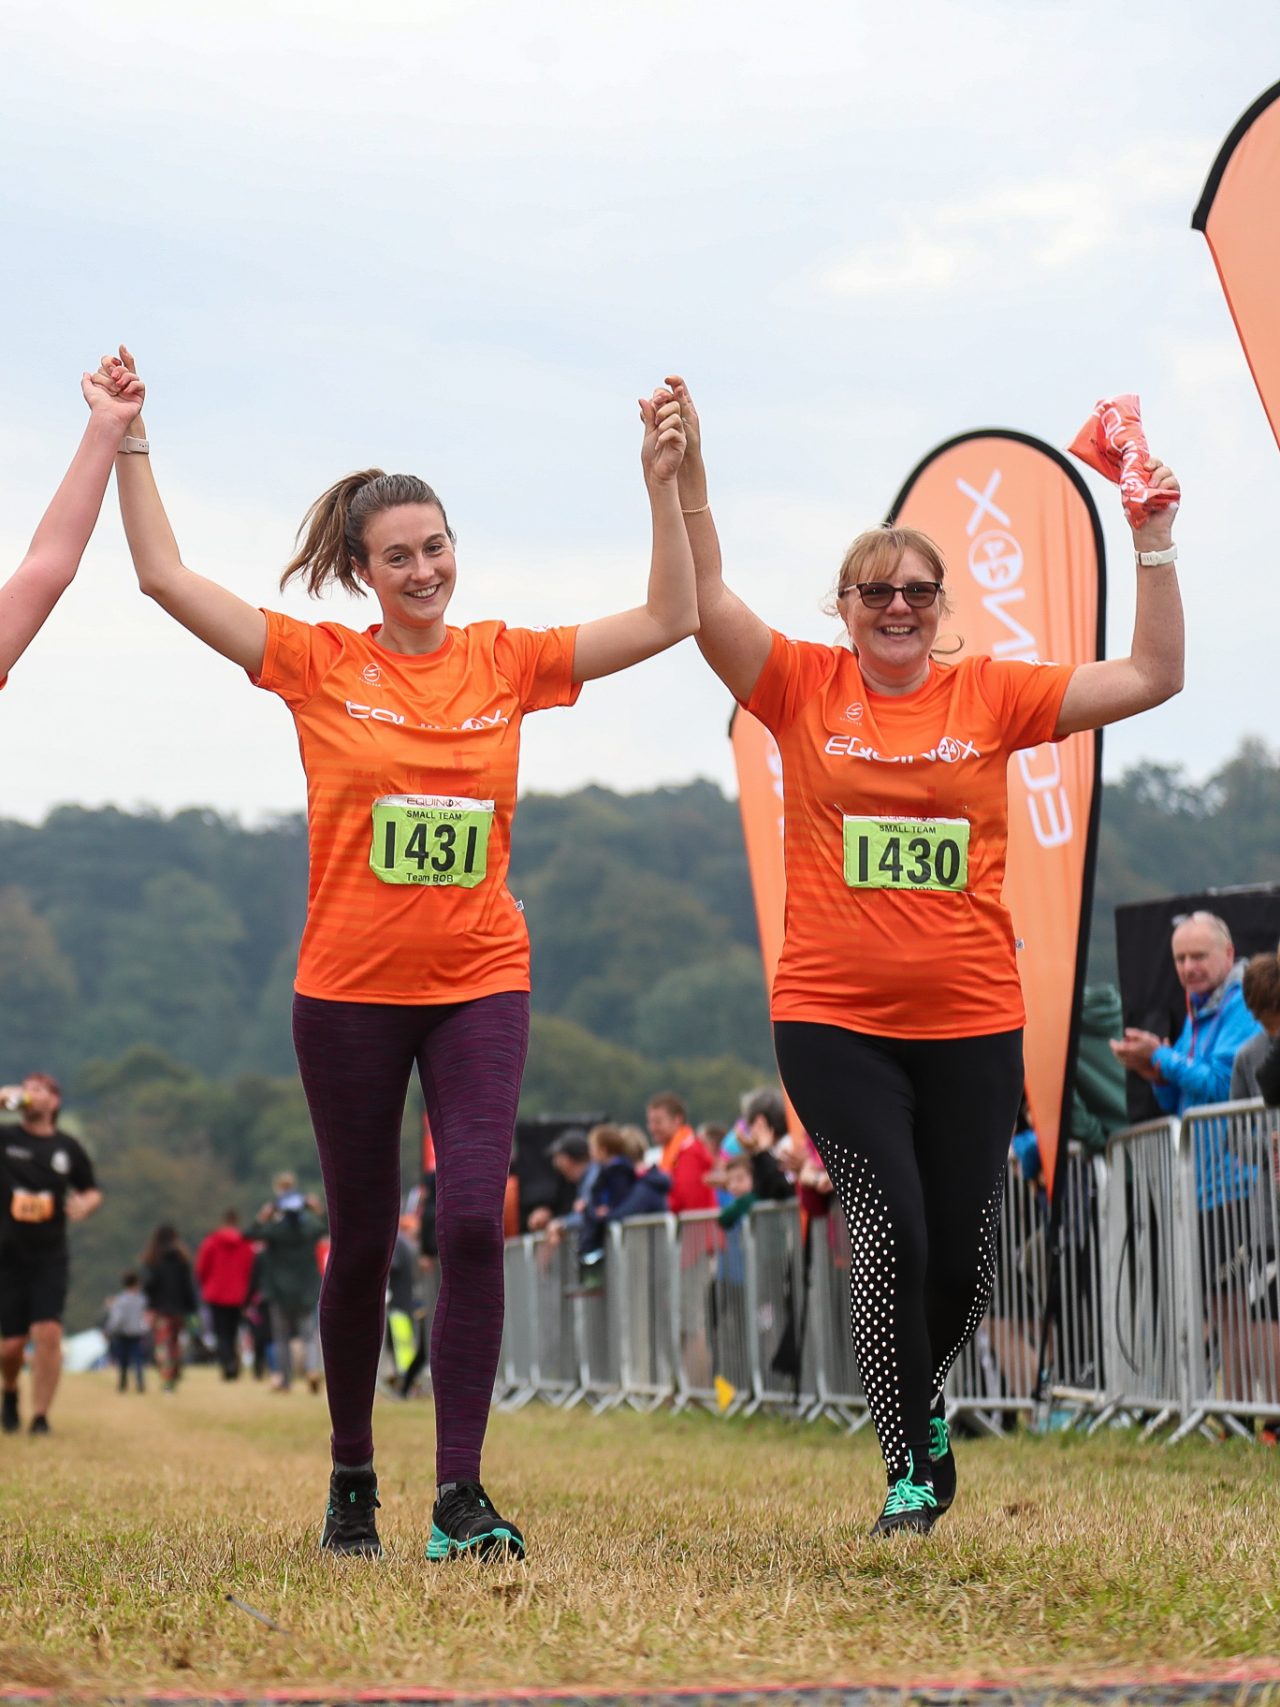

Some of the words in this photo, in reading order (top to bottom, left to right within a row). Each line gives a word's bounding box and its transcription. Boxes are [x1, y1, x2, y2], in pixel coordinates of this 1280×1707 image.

[406, 797, 463, 807] EQUINOX
[407, 810, 436, 819] SMALL
[439, 812, 462, 821] TEAM
[880, 824, 910, 834] SMALL
[912, 826, 937, 834] TEAM
[385, 821, 478, 873] 1431
[858, 835, 960, 887] 1430
[406, 873, 430, 882] Team
[433, 874, 454, 883] BOB
